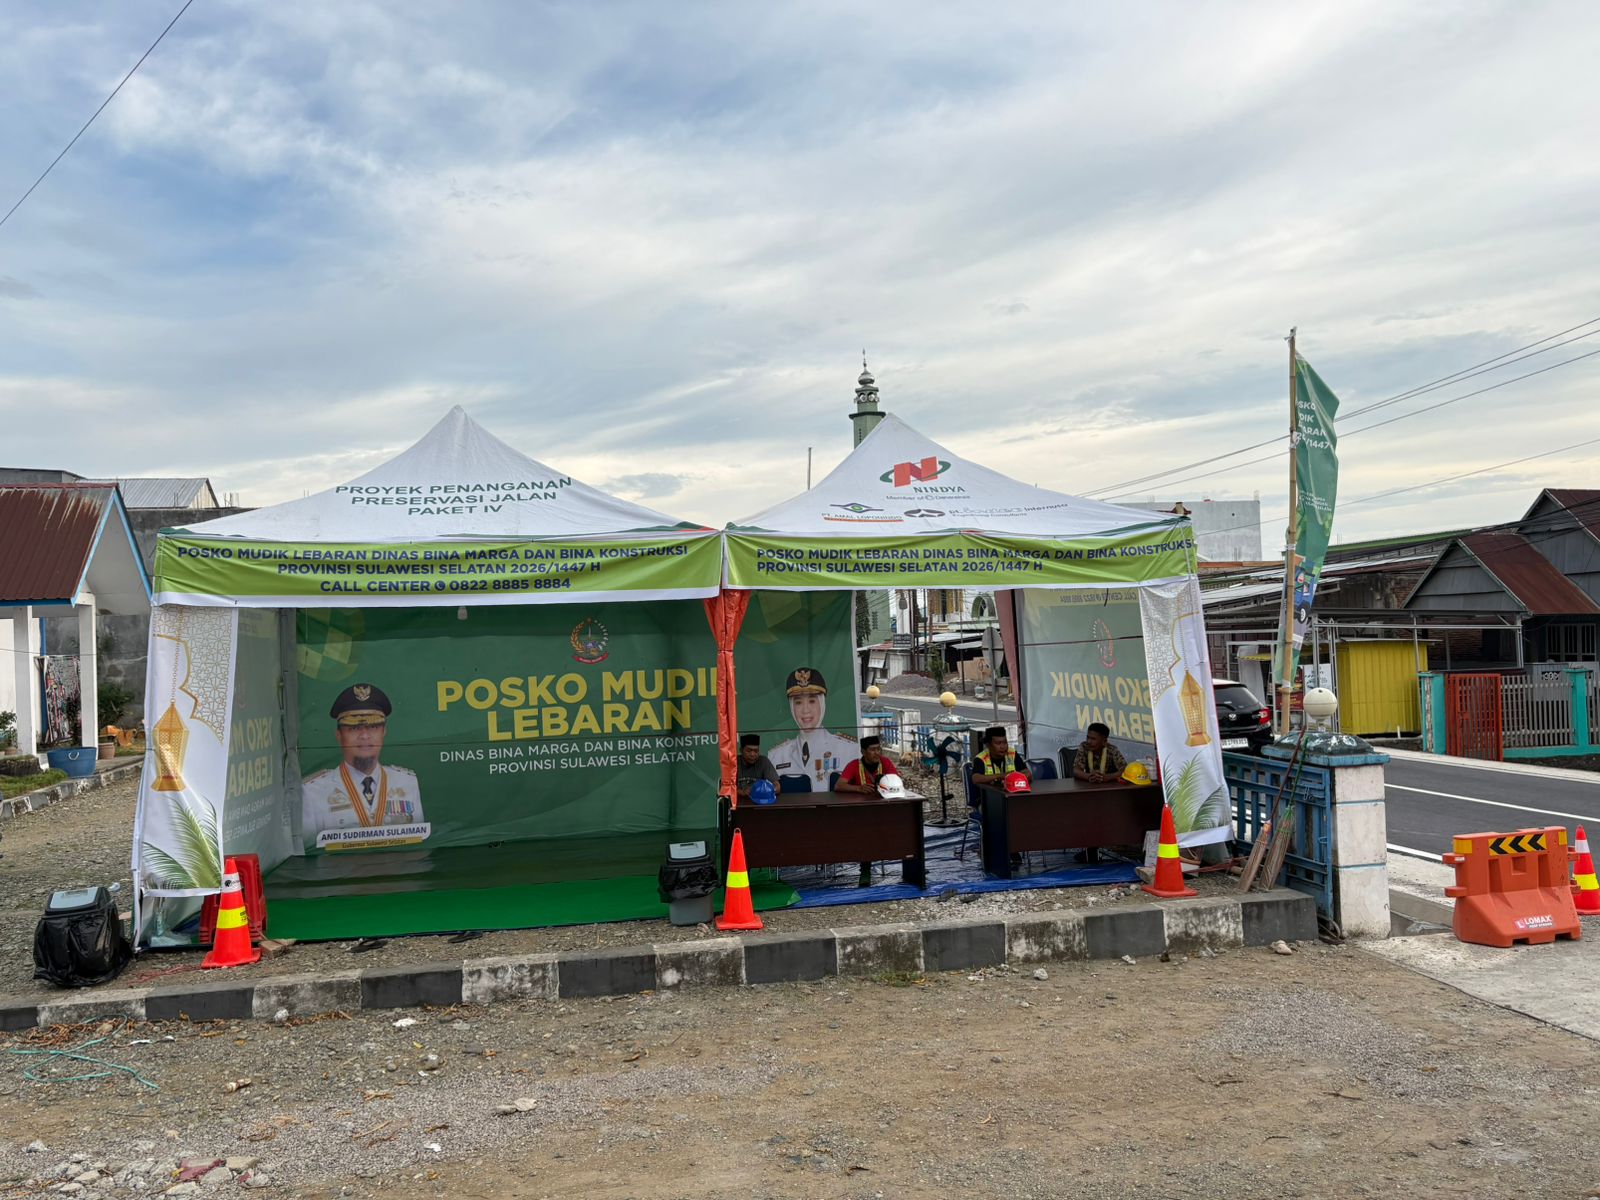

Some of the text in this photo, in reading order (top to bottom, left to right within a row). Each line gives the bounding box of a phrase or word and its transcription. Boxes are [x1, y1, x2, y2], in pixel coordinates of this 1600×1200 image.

[335, 477, 572, 494] PROYEK PENANGANAN
[351, 492, 557, 505] PRESERVASI JALAN
[408, 504, 502, 515] PAKET IV
[178, 545, 688, 560] POSKO MUDIK LEBARAN DINAS BINA MARGA DAN BINA KONSTRUKSI
[757, 548, 804, 560] POSKO
[808, 549, 852, 560] MUDIK
[856, 549, 919, 560] LEBARAN
[923, 548, 963, 558] DINAS
[968, 548, 999, 558] BINA
[1004, 549, 1050, 560] MARGA
[1054, 550, 1083, 560] DAN
[1087, 548, 1116, 559] BINA
[278, 562, 600, 575] PROVINSI SULAWESI SELATAN 2026/1447 H
[757, 561, 1042, 572] PROVINSI SULAWESI SELATAN 2026/1447 H
[320, 578, 572, 592] CALL CENTER 0822 8885 8884
[437, 667, 718, 712] POSKO MUDI
[488, 700, 692, 742] LEBARAN
[440, 732, 739, 762] DINAS BINA MARGA DAN BINA KONSTRUI
[489, 750, 696, 774] PROVINSI SULAWESI SELATAN
[321, 826, 427, 841] ANDI SUDIRMAN SULAIMAN
[1524, 915, 1552, 925] LOMAX
